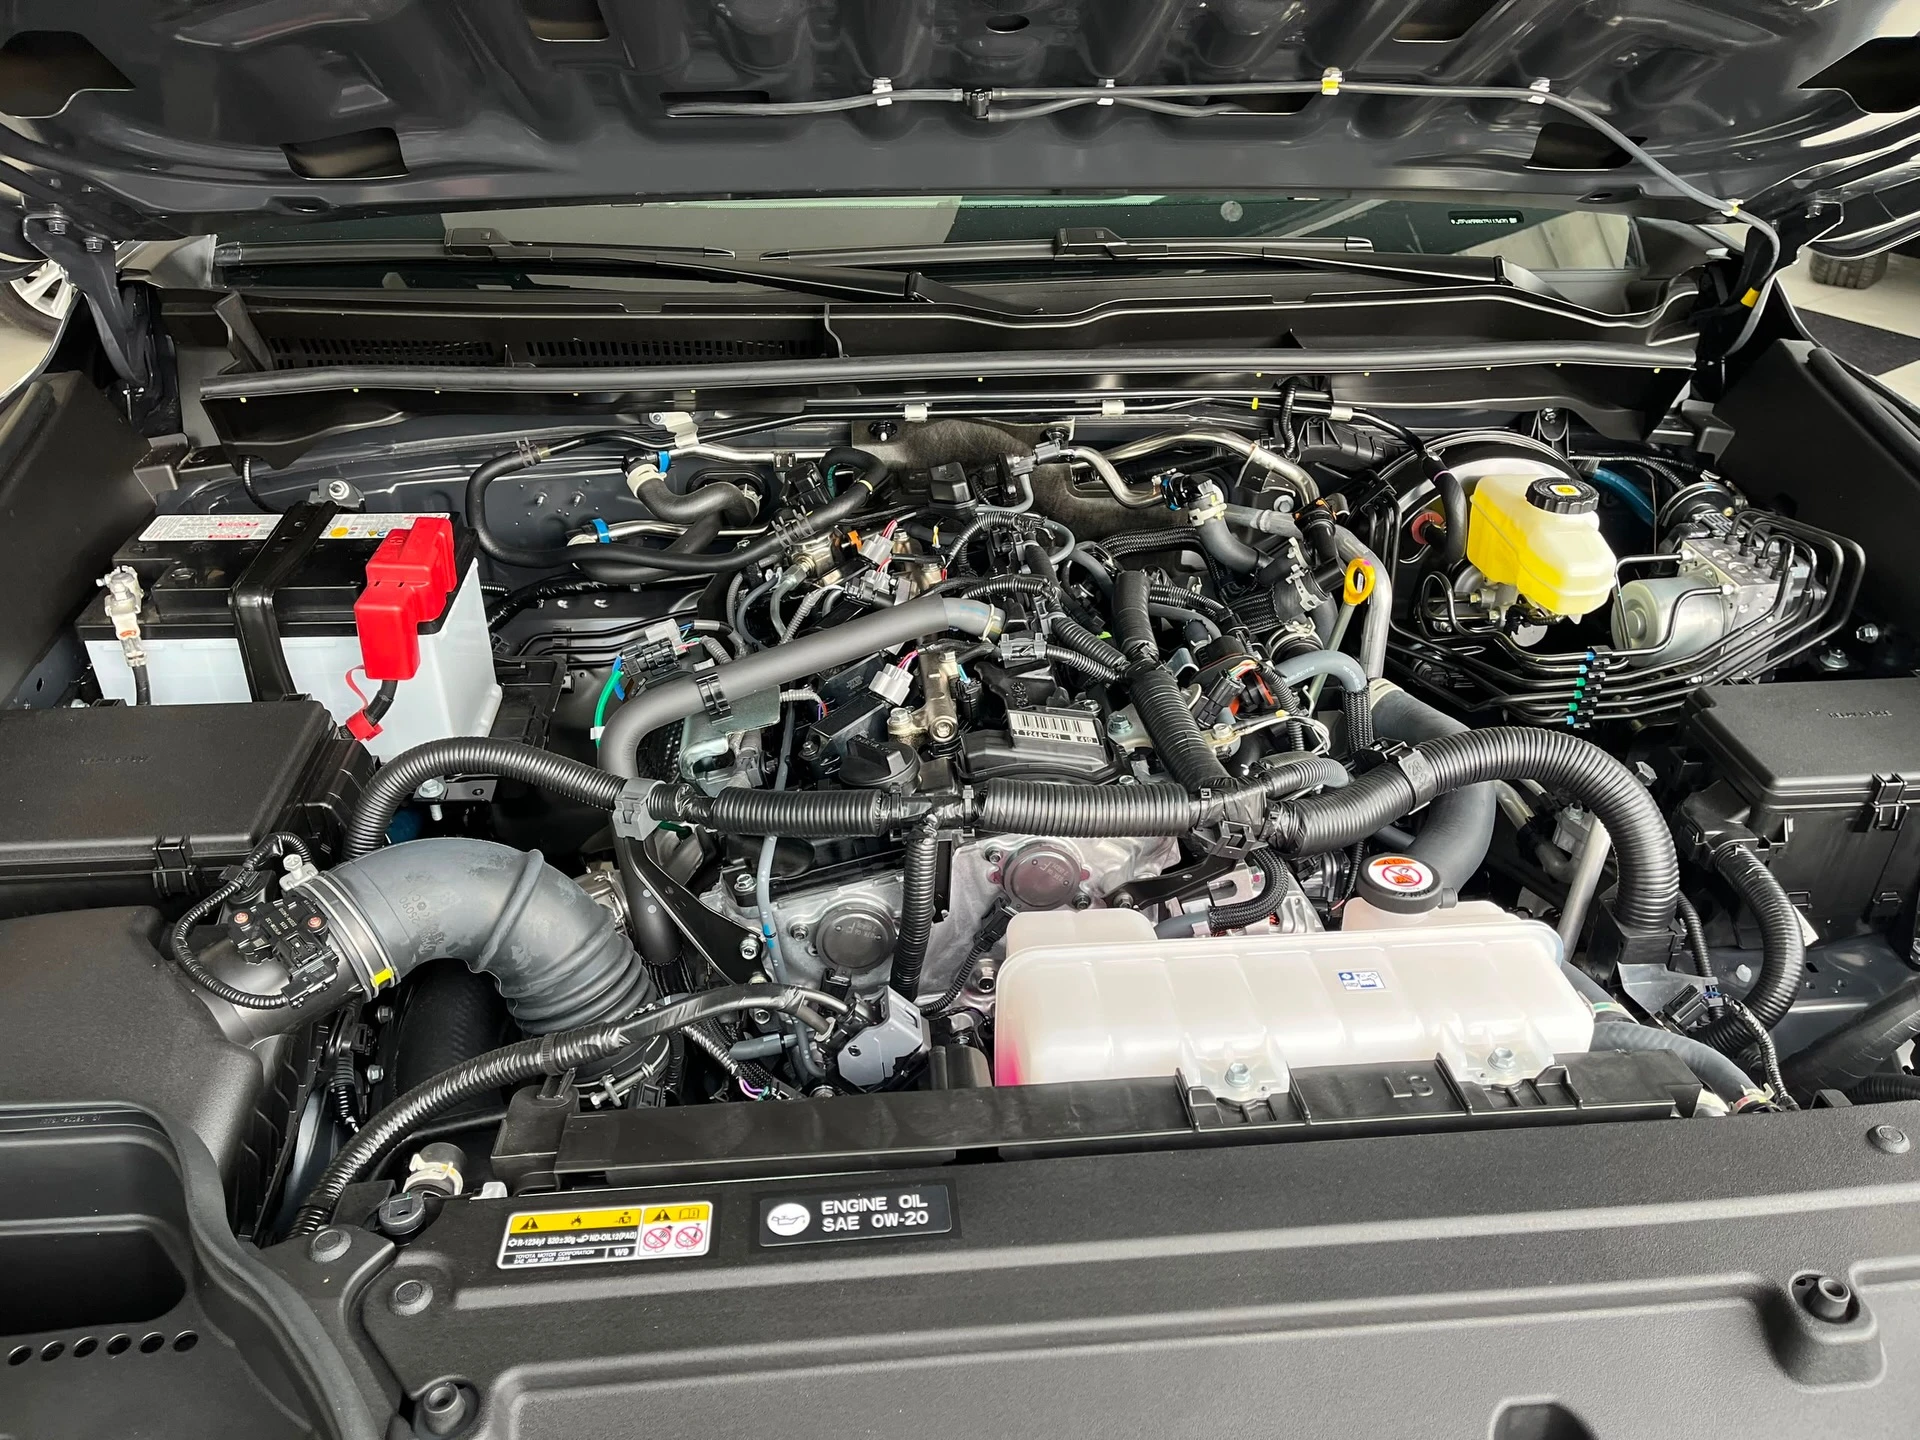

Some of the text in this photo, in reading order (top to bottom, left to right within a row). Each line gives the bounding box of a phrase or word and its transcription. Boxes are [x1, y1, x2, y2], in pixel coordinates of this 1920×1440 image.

[821, 1193, 929, 1216] ENGINE OIL
[821, 1210, 930, 1233] SAE 0W-20
[537, 1251, 557, 1259] MOTOR
[558, 1249, 595, 1257] CORPORATION
[614, 1247, 629, 1257] W9
